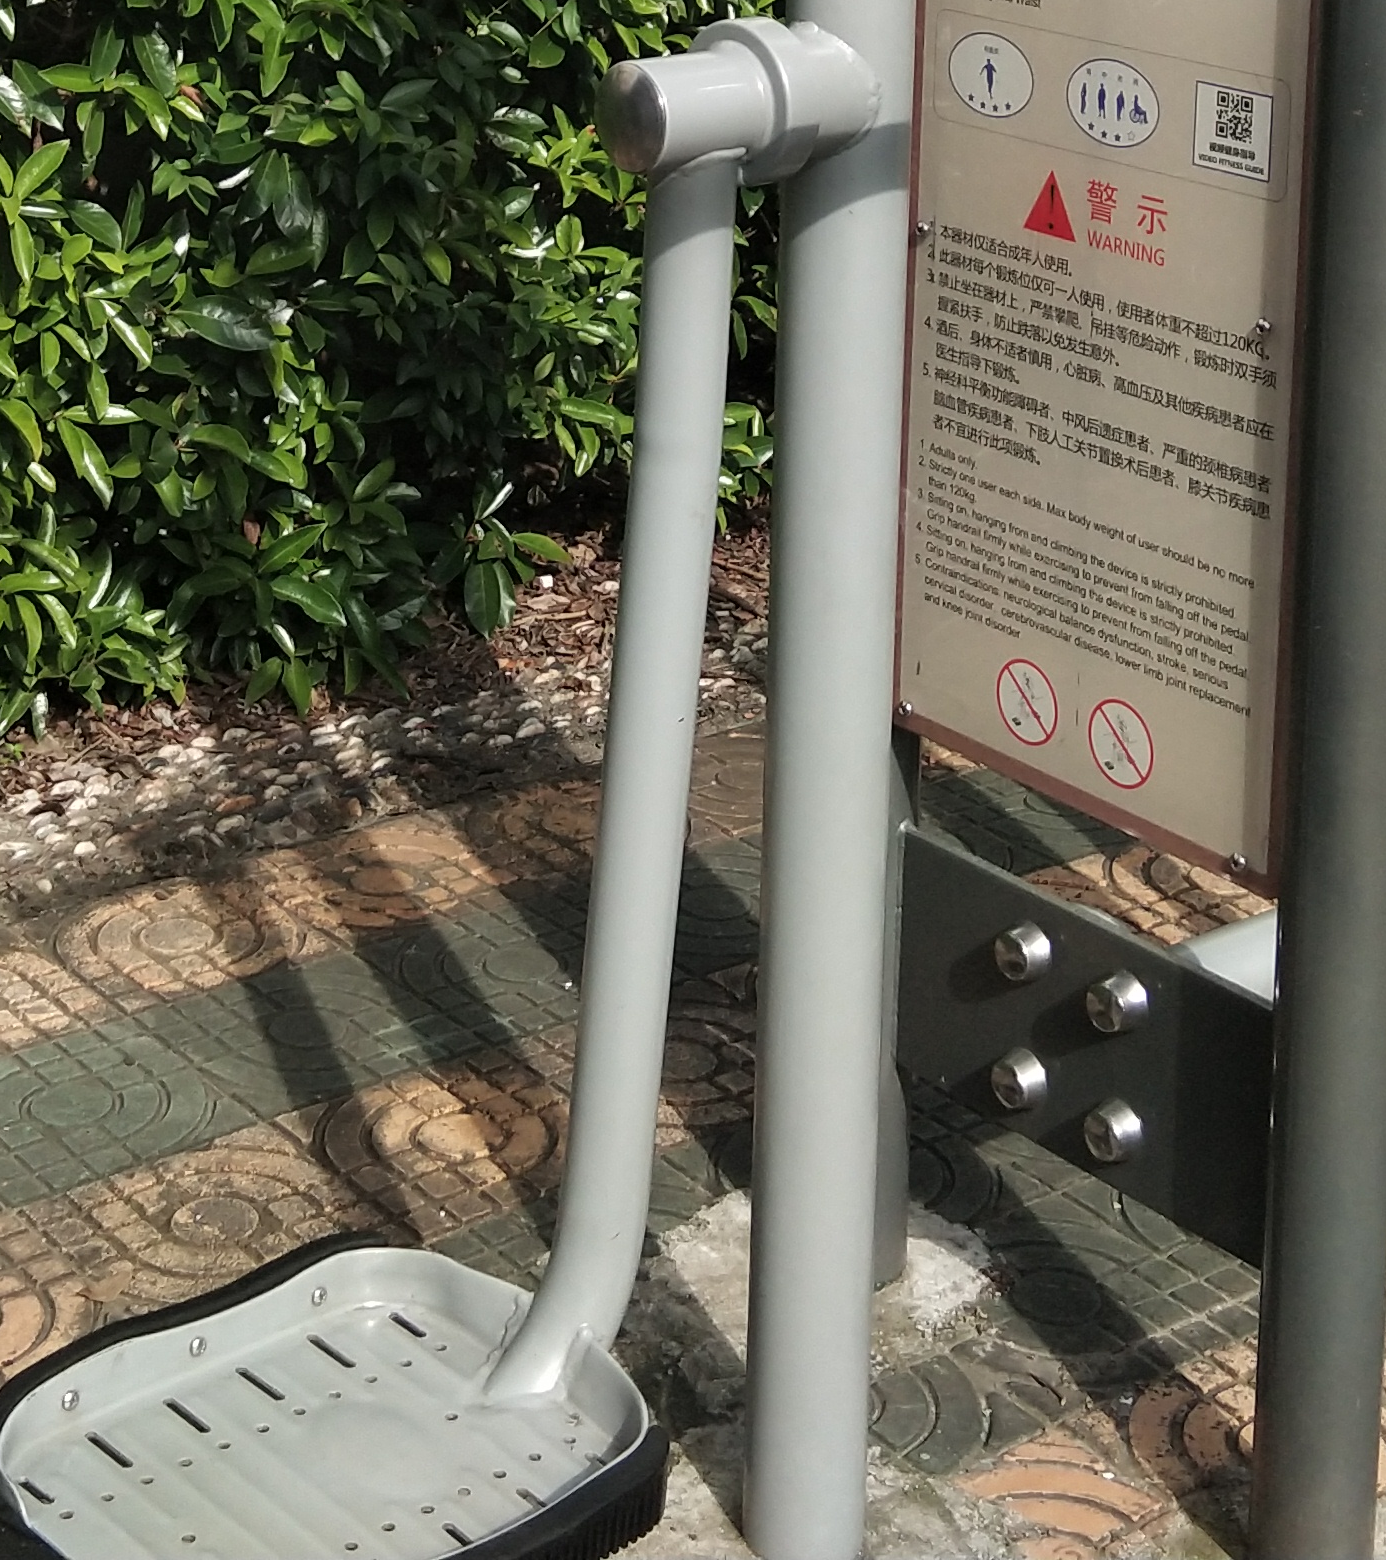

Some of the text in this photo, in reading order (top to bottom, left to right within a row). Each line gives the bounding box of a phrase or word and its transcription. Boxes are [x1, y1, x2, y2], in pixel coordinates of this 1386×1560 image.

[1198, 153, 1218, 164] VIDEO
[1219, 158, 1243, 170] FITNESS
[1087, 228, 1166, 268] WARNING
[928, 476, 947, 491] than
[928, 458, 958, 480] Strictly
[959, 471, 976, 486] one
[977, 479, 997, 492] user
[999, 486, 1021, 501] each
[1046, 502, 1066, 519] Max
[1068, 509, 1091, 530] body
[1093, 522, 1125, 541] weight
[1126, 533, 1137, 545] of
[1138, 539, 1160, 553] user
[1162, 546, 1195, 567] should
[1197, 558, 1211, 573] be
[1213, 566, 1226, 579] no
[1228, 572, 1255, 589] more
[926, 524, 953, 546] Sitting
[970, 542, 1005, 567] hanging
[1007, 556, 1027, 573] from
[1029, 567, 1047, 581] and
[1049, 574, 1087, 599] climbing
[1089, 588, 1104, 604] the
[1106, 596, 1137, 617] device
[1139, 609, 1147, 621] is
[1150, 613, 1182, 636] strictly
[927, 508, 945, 525] Grip
[947, 515, 981, 536] handrail
[983, 530, 1007, 550] firmly
[1008, 541, 1032, 558] while
[1033, 551, 1080, 578] exercising
[1082, 568, 1092, 581] to
[1093, 574, 1130, 596] prevent
[1131, 586, 1153, 604] from
[1155, 595, 1184, 619] falling
[1186, 610, 1200, 624] off
[1202, 616, 1218, 631] the
[928, 491, 954, 513] Sitting
[971, 508, 1007, 534] hanging
[1008, 522, 1029, 539] from
[1031, 532, 1048, 546] and
[1050, 540, 1088, 564] climbing
[1090, 554, 1106, 569] the
[1107, 561, 1139, 582] device
[1141, 574, 1149, 586] is
[1151, 578, 1183, 601] strictly
[924, 592, 940, 606] and
[942, 598, 963, 616] knee
[965, 607, 983, 620] joint
[924, 576, 957, 596] cervical
[1001, 606, 1073, 643] cerebrovascular
[1115, 651, 1141, 671] lower
[1143, 664, 1164, 681] limb
[1165, 673, 1187, 693] joint
[1189, 684, 1252, 718] replacement
[925, 541, 944, 557] Grip
[946, 549, 980, 571] handrail
[982, 563, 1005, 584] firmly
[1008, 575, 1031, 591] while
[1032, 585, 1079, 613] exercising
[1080, 603, 1090, 615] to
[1092, 609, 1128, 630] prevent
[1129, 621, 1151, 640] from
[1154, 632, 1183, 655] falling
[1185, 645, 1199, 658] off
[1200, 652, 1216, 667] the
[1003, 590, 1057, 619] neurological
[1059, 612, 1095, 635] balance
[1192, 668, 1229, 690] serious
